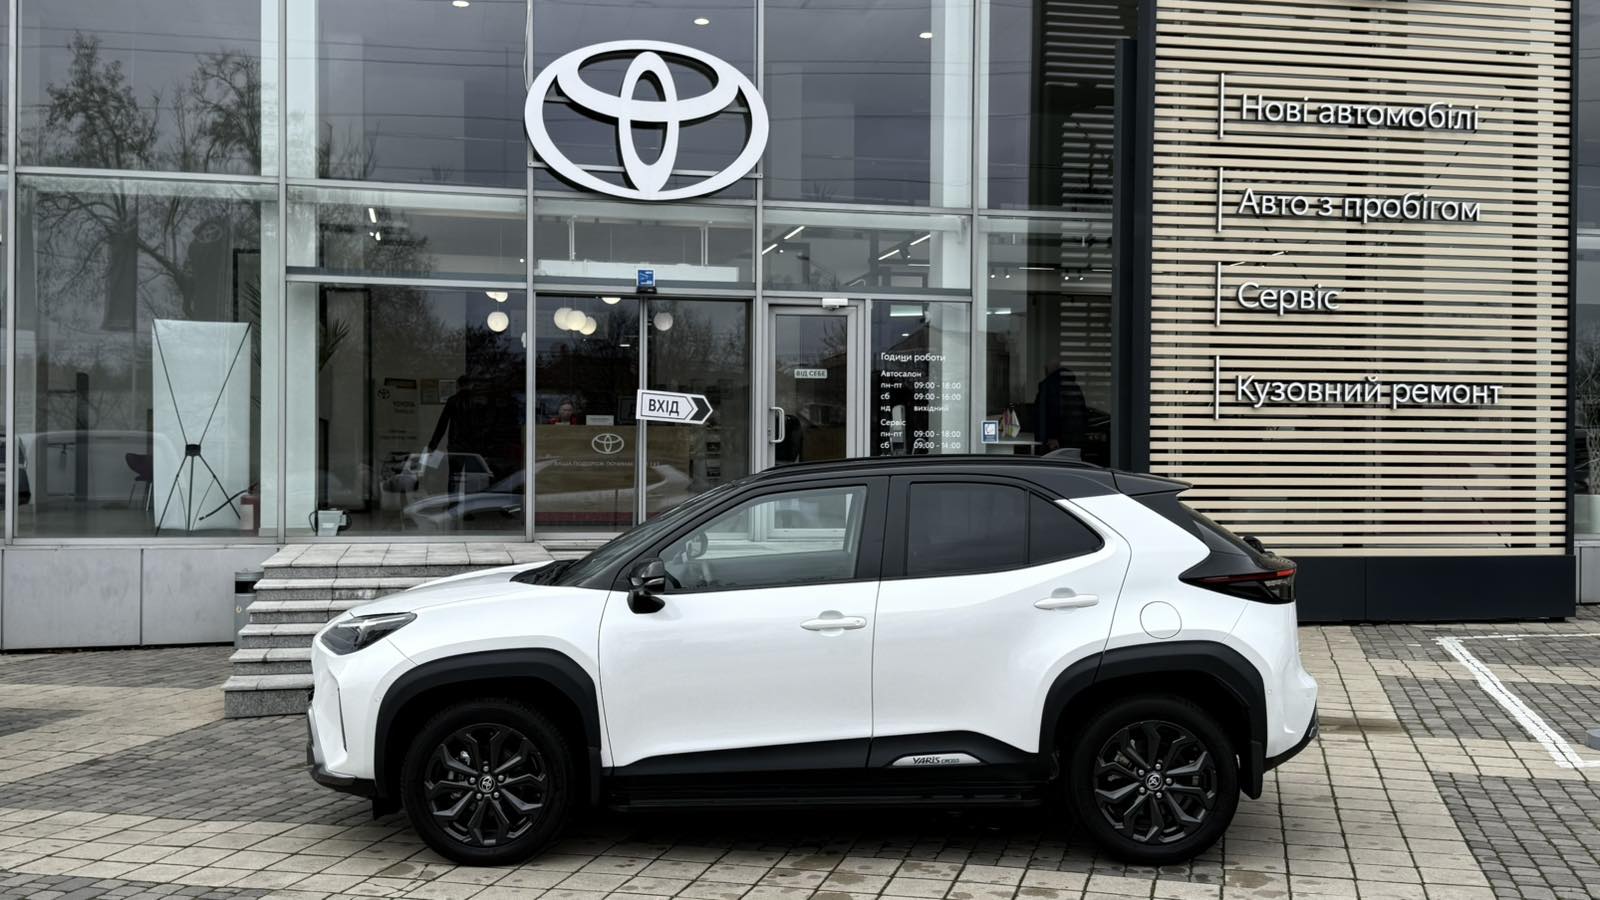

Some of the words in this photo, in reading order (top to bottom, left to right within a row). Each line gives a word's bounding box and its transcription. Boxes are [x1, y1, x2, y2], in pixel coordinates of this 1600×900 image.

[1241, 93, 1309, 123] Нові
[1318, 101, 1480, 130] автомобілі
[1238, 187, 1309, 216] Авто
[1318, 195, 1334, 217] з
[1344, 192, 1481, 224] пробігом
[1237, 281, 1340, 316] Сервіс
[880, 352, 913, 362] Години
[914, 353, 946, 364] роботи
[880, 370, 922, 378] Автосалон
[1237, 375, 1382, 409] Кузовний
[1392, 382, 1504, 410] ремонт
[648, 398, 680, 416] ВХІД
[880, 418, 906, 427] Сервіс
